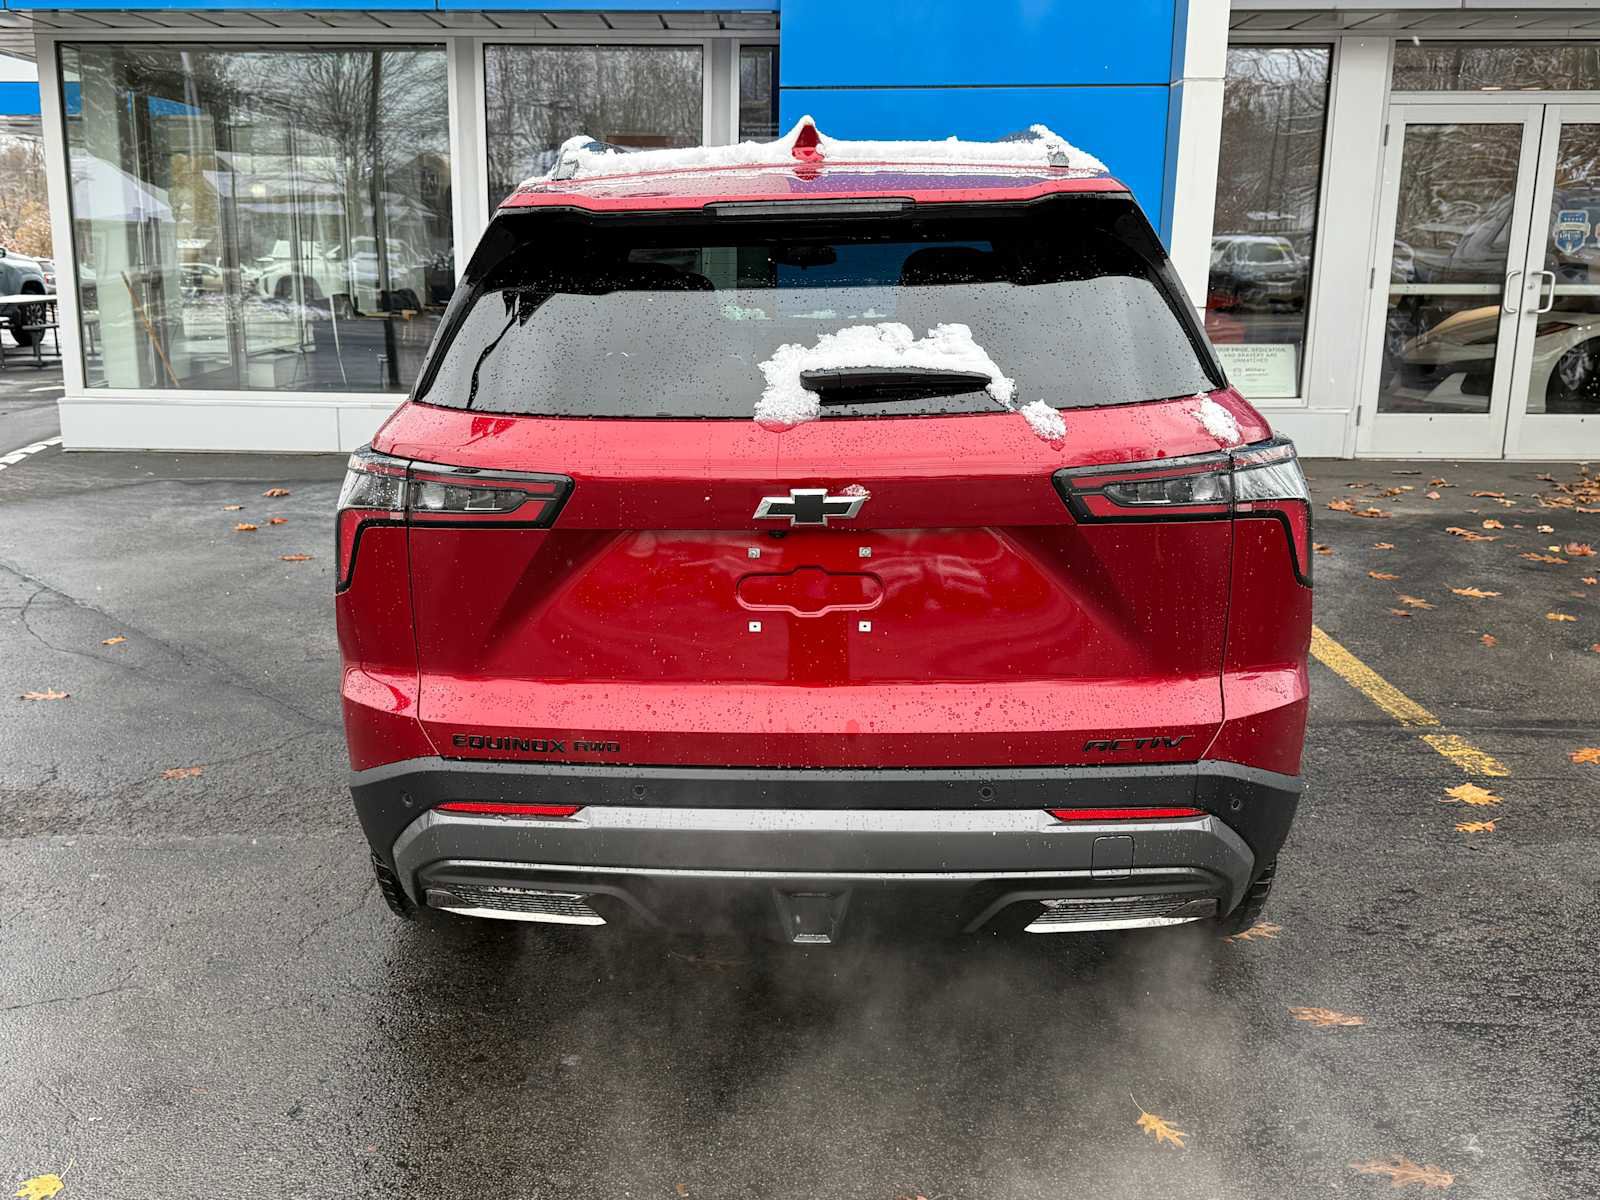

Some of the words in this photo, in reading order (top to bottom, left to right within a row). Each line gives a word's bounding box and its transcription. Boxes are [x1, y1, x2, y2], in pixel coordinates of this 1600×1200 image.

[452, 733, 565, 753] EQUINOX
[573, 740, 621, 753] AWD
[1083, 735, 1193, 753] ACTIV
